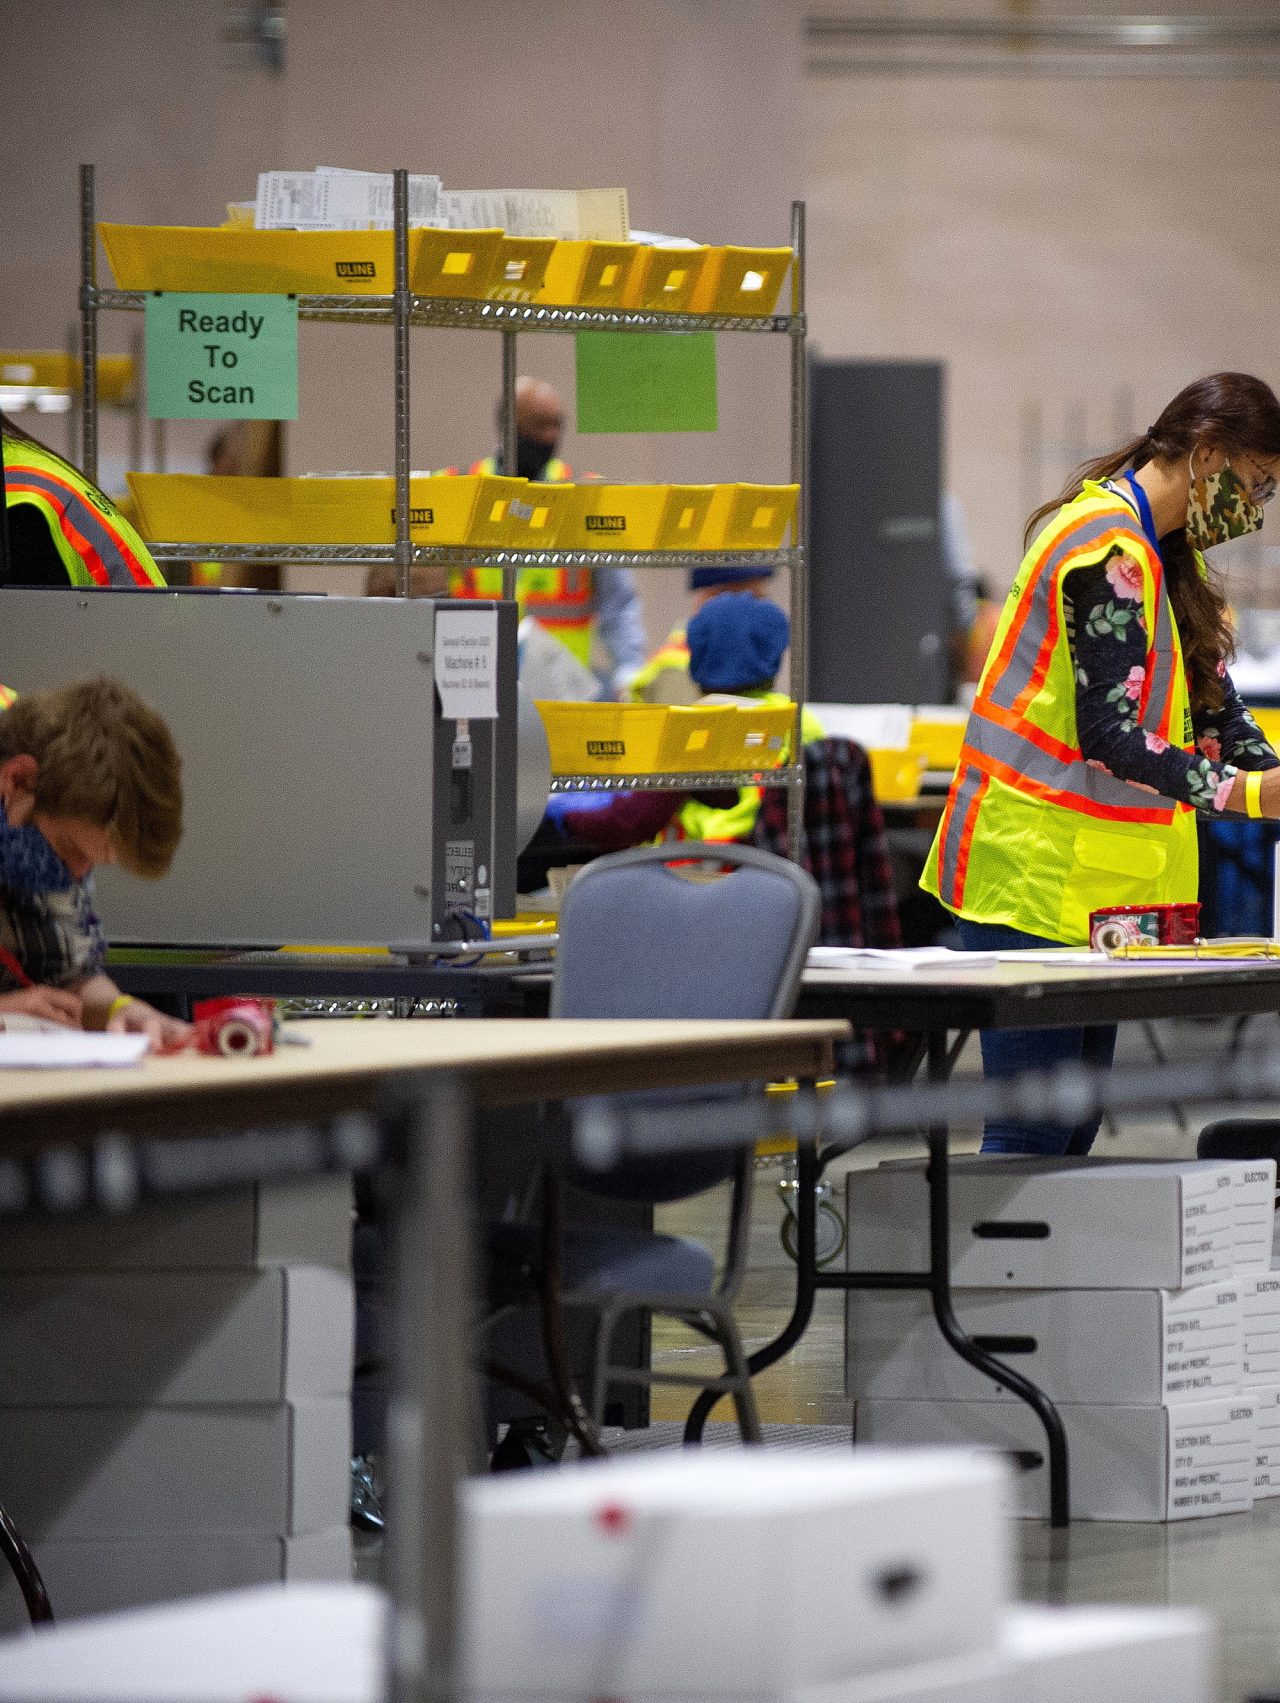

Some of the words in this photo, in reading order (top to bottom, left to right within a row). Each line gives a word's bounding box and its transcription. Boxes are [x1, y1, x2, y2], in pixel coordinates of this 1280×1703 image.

[337, 263, 374, 276] ULINE
[179, 309, 264, 339] Ready
[204, 345, 238, 368] To
[189, 380, 254, 404] Scan
[588, 517, 624, 529] ULINE
[588, 743, 624, 754] ULINE
[1244, 1172, 1269, 1183] ELECTION
[1255, 1474, 1270, 1486] LLOTS
